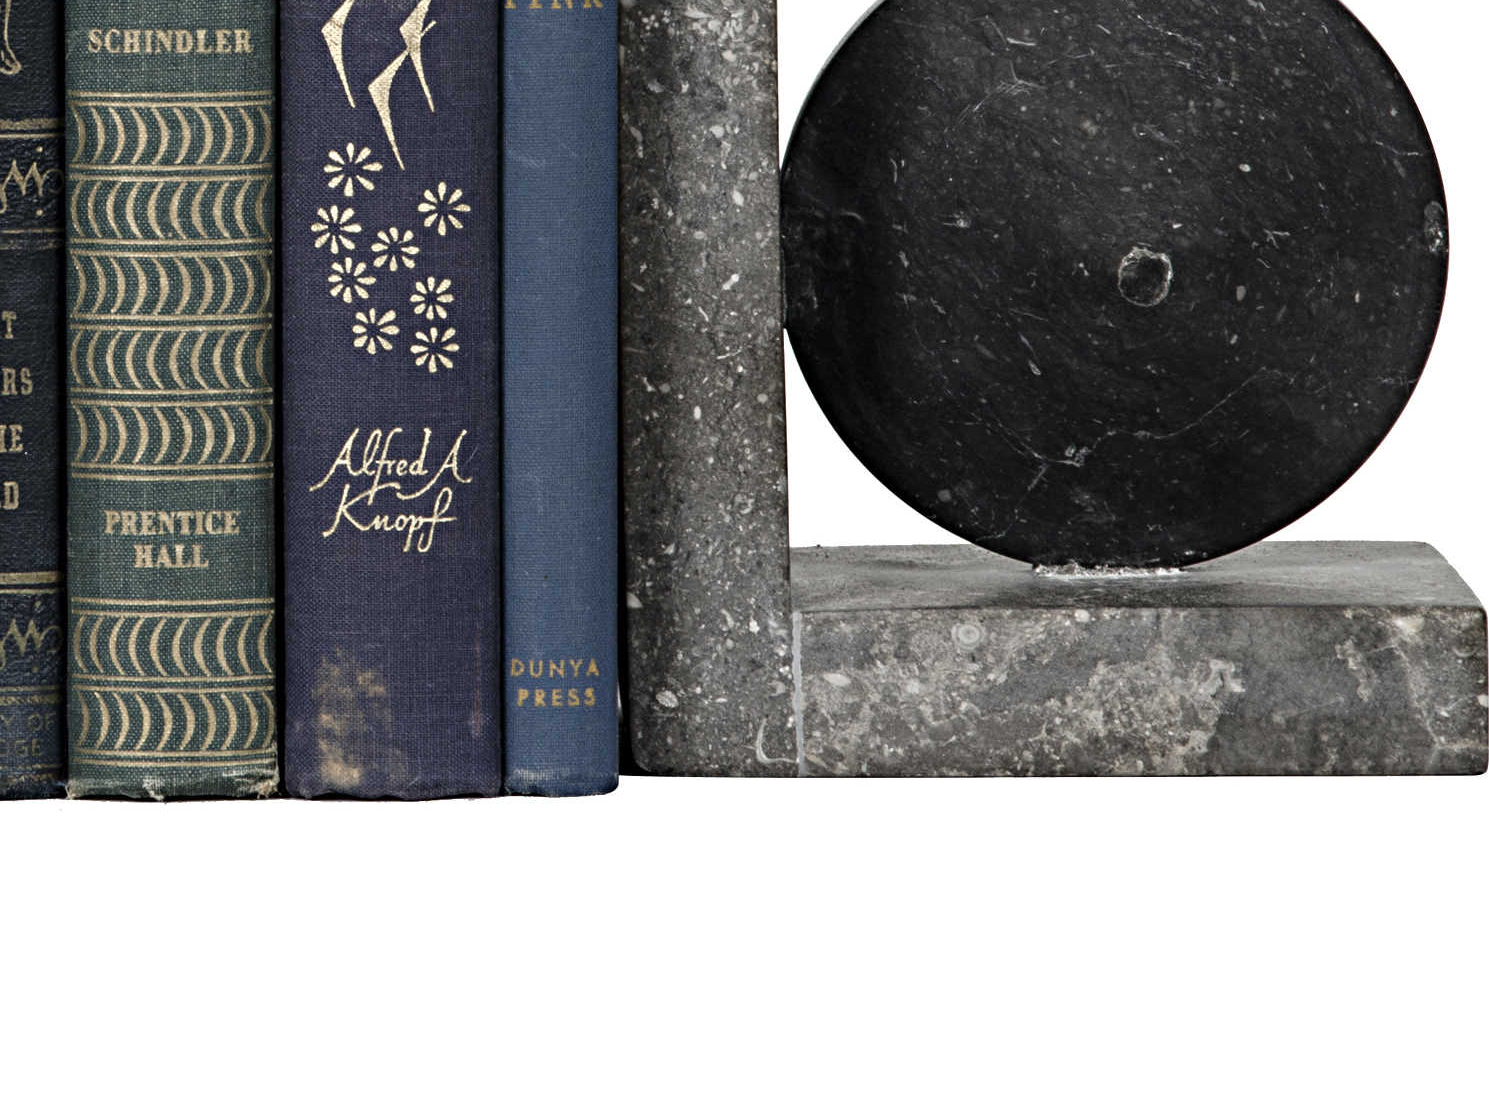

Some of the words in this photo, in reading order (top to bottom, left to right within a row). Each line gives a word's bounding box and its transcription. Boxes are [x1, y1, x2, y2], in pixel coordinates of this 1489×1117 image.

[86, 27, 254, 54] SCHINDLER
[310, 427, 429, 504] Alfred
[396, 428, 473, 500] A
[103, 509, 241, 536] PRENTICE
[322, 483, 458, 552] Knopf
[133, 544, 211, 569] HALL
[510, 657, 601, 678] DUNYA
[516, 687, 597, 707] PRESS
